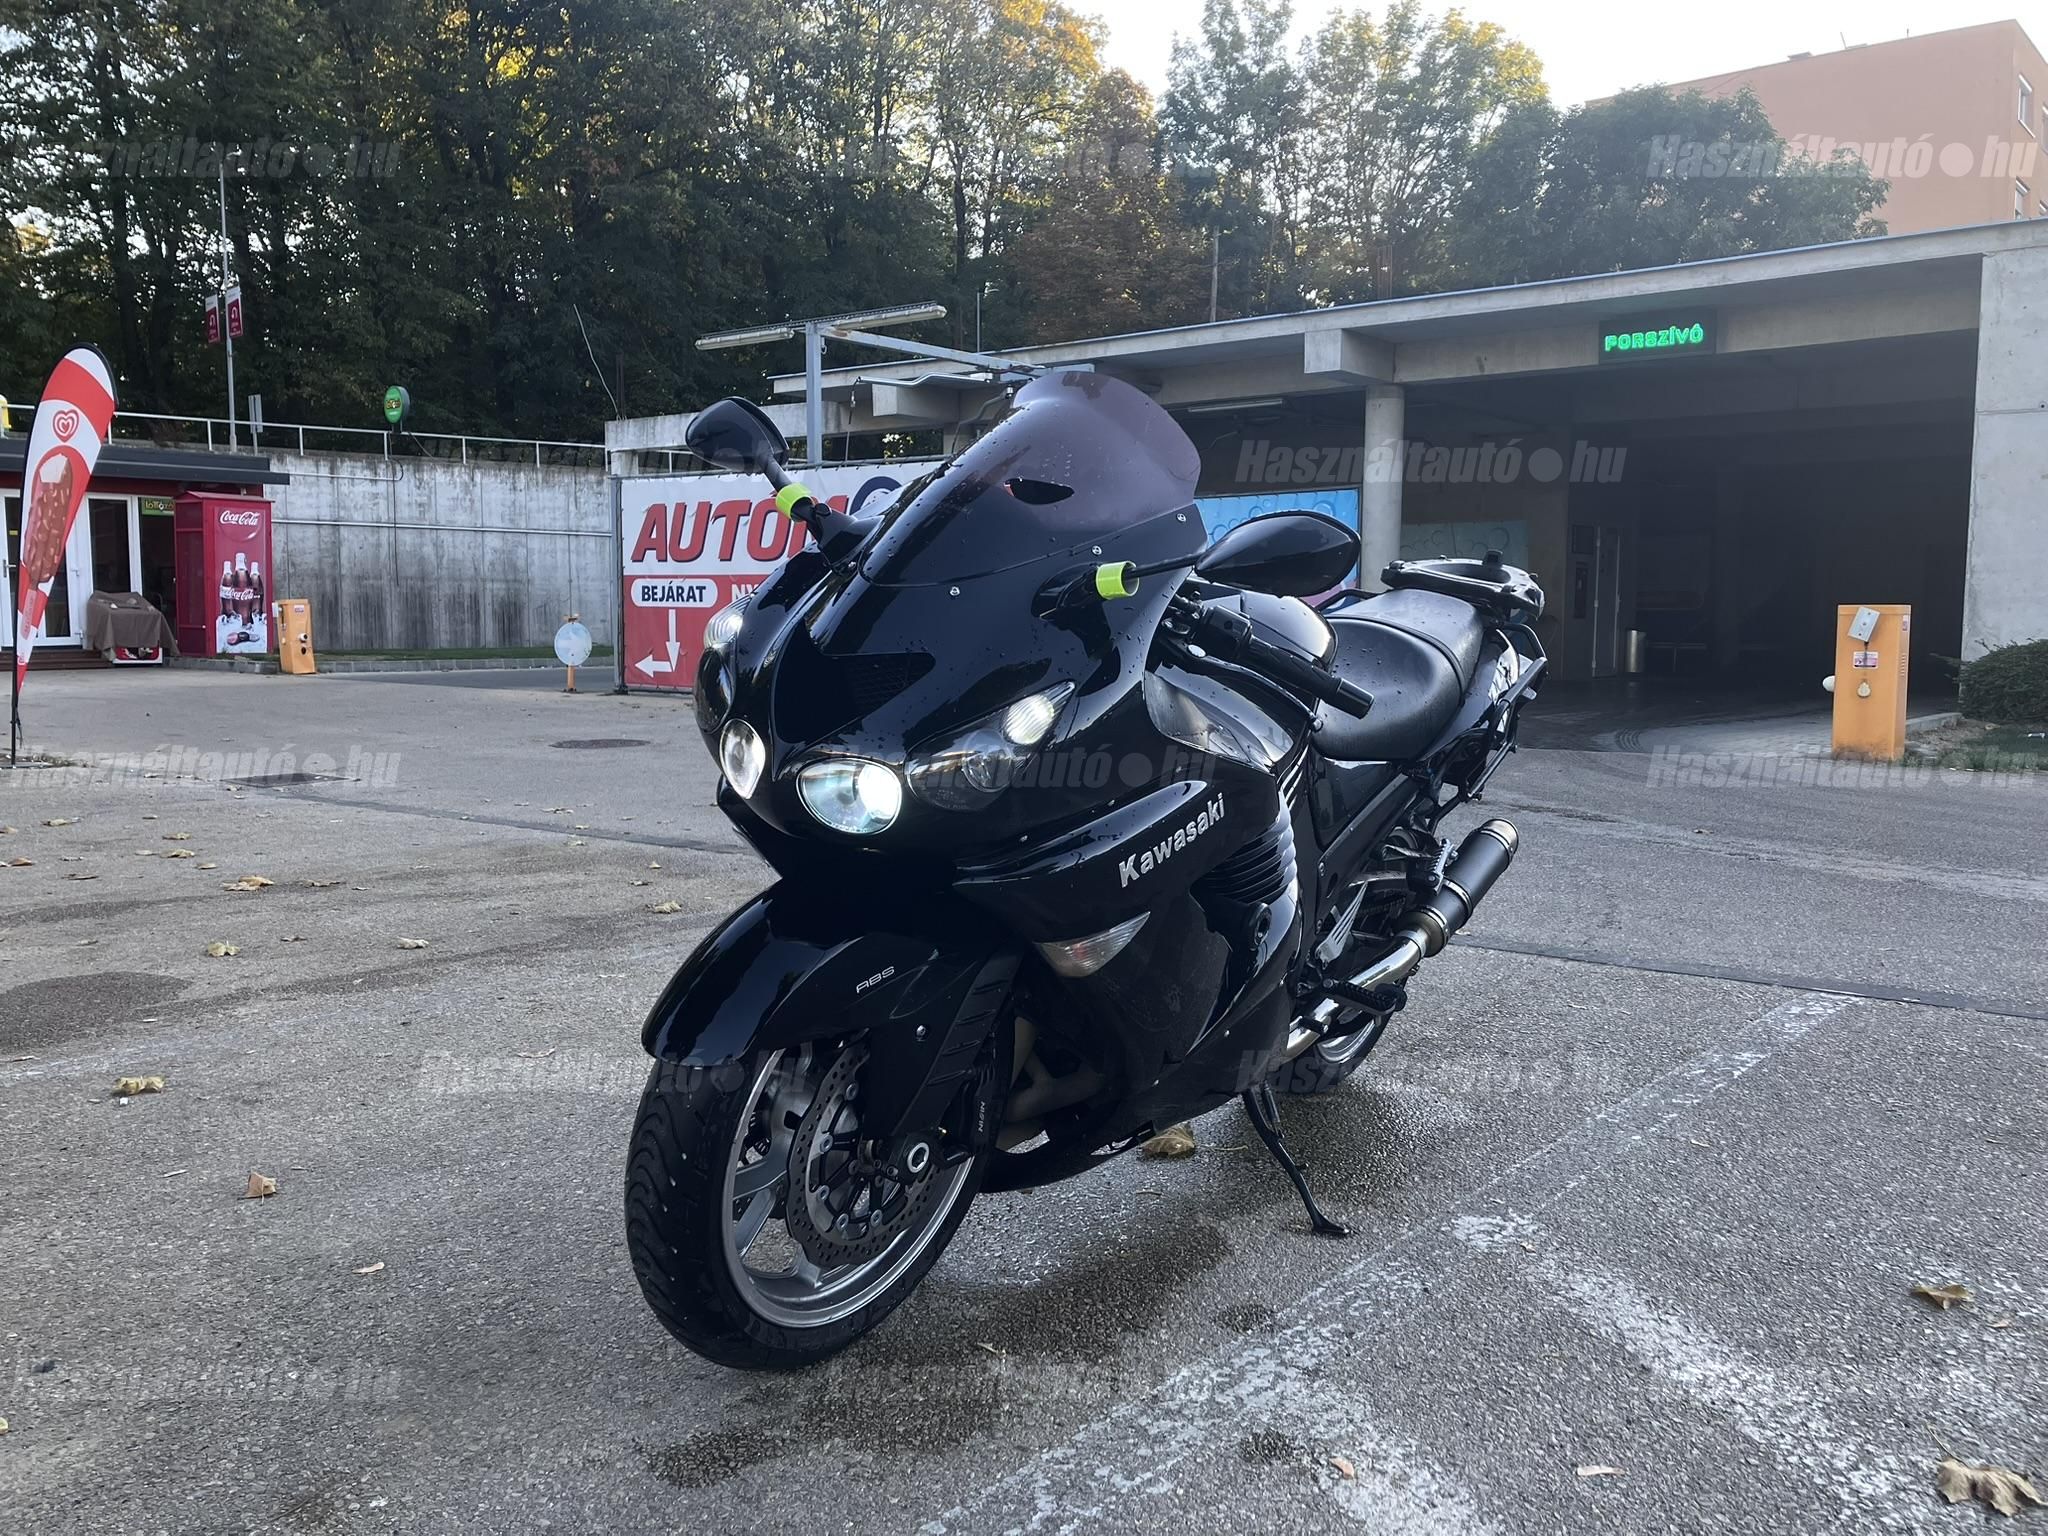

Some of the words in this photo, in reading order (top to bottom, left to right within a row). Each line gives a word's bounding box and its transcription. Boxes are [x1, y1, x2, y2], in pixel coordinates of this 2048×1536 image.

[641, 580, 707, 603] BEJÁRAT
[1118, 792, 1225, 888] Kawasaki
[855, 965, 895, 994] ABS
